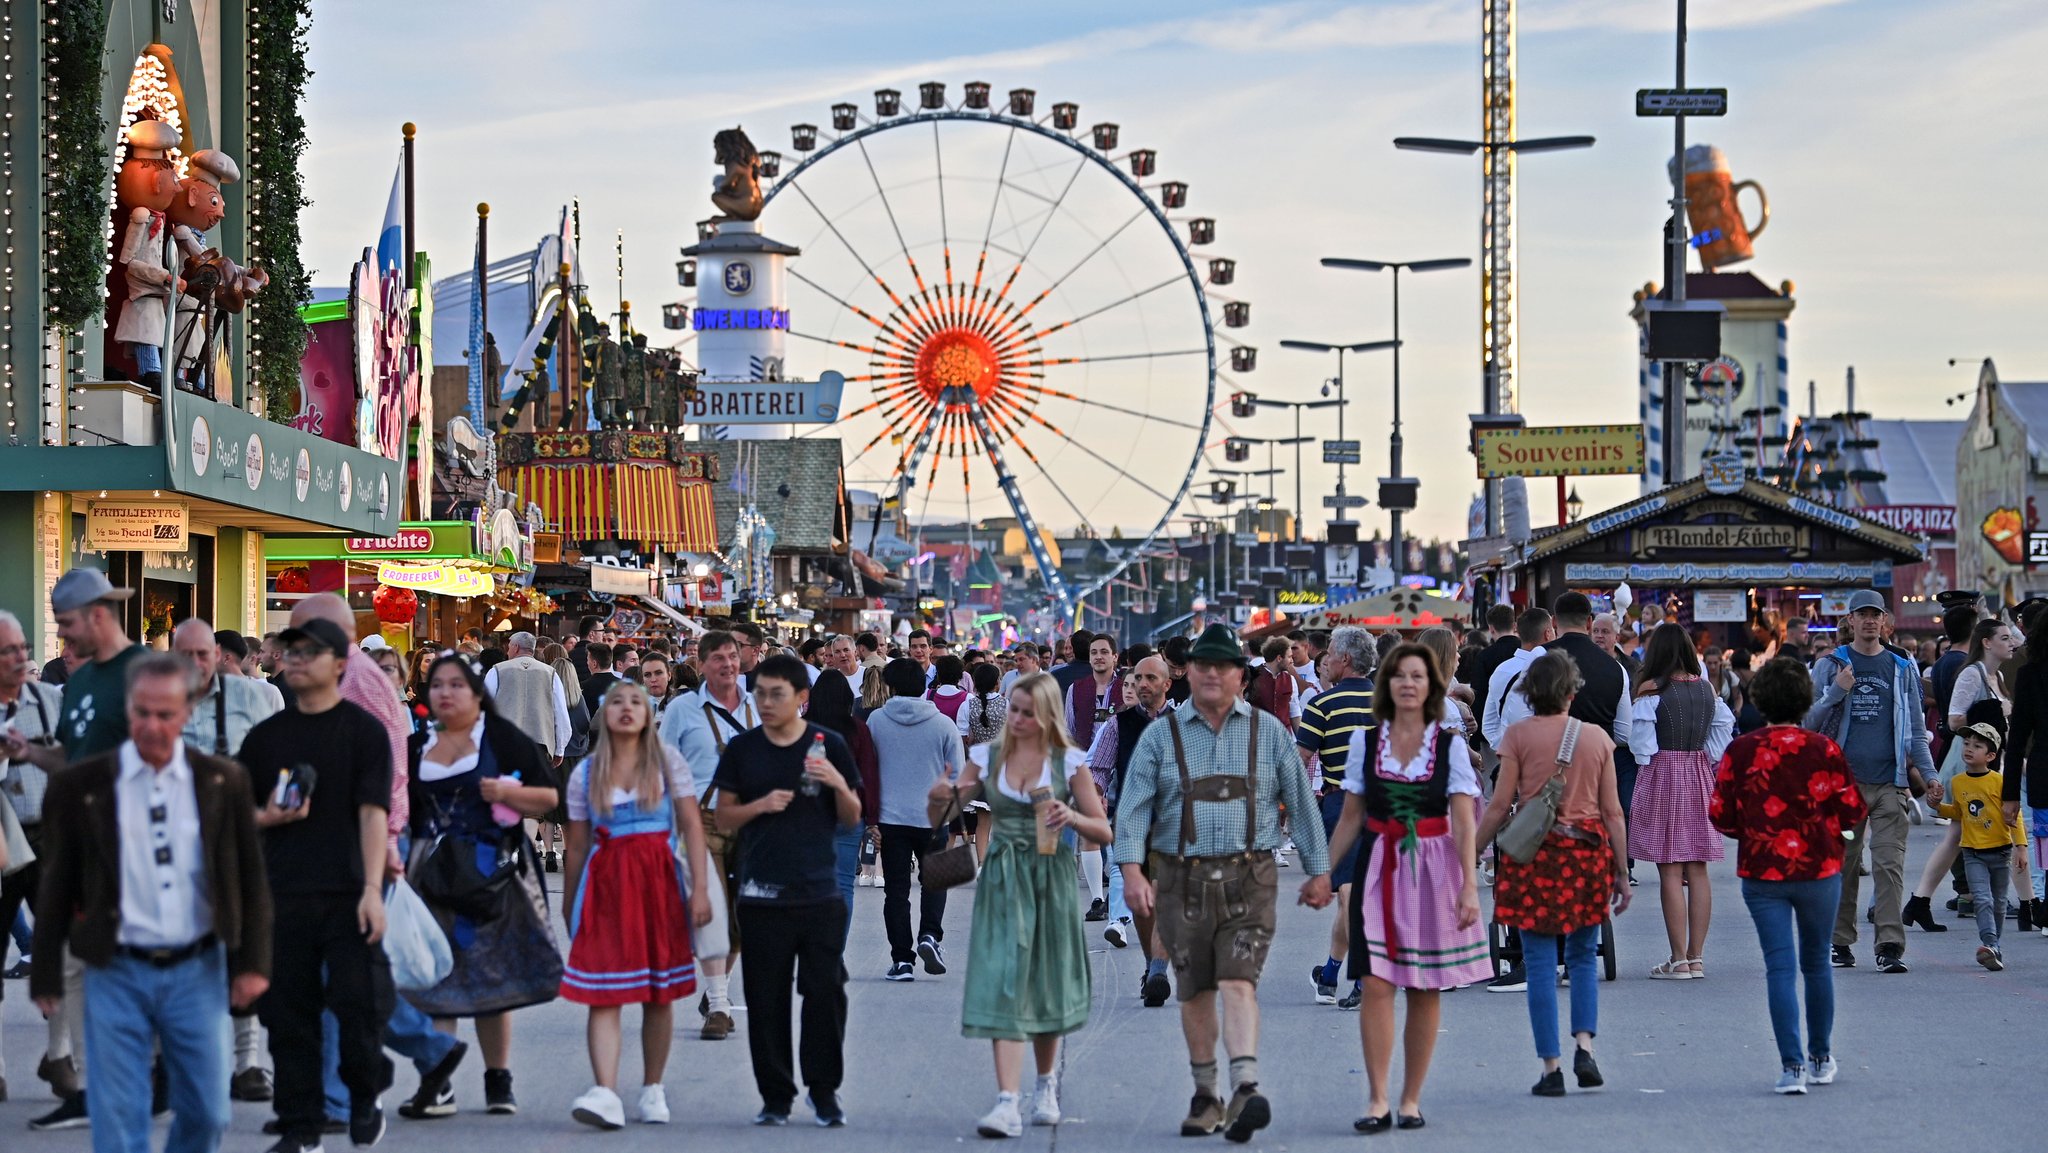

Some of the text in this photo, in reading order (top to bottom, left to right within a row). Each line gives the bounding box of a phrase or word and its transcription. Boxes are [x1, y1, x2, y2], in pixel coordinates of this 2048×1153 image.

[1496, 437, 1625, 465] Souvenirs
[93, 508, 181, 518] FAMILIENTAG
[1592, 500, 1659, 531] Gebrannte
[1795, 497, 1853, 528] Mandeln
[121, 527, 152, 538] Hendl
[1653, 526, 1793, 546] Mandel-Küche
[2029, 539, 2048, 555] FI
[382, 569, 440, 583] ERDBEEREN
